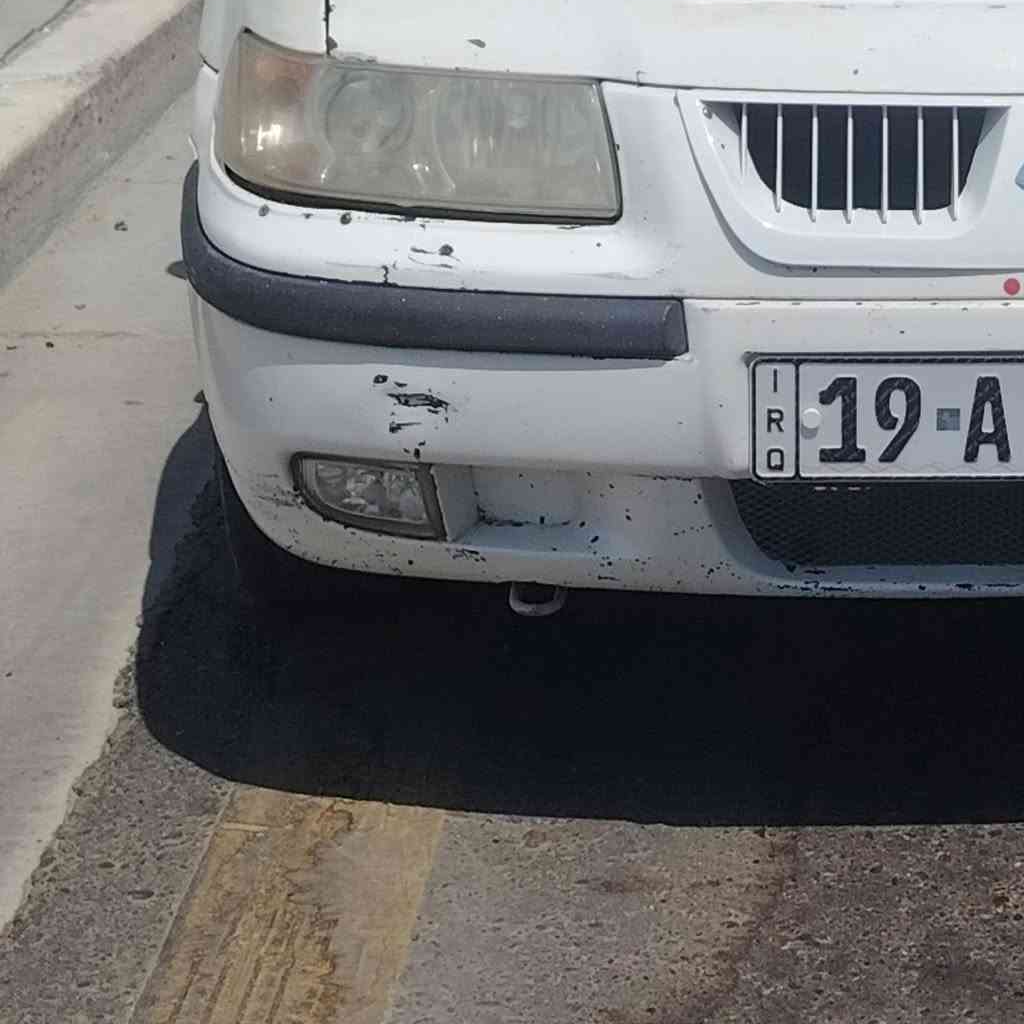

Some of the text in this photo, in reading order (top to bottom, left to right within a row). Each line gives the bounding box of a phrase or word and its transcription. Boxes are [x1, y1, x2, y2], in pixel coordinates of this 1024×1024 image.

[766, 367, 786, 472] IRQ
[818, 376, 923, 463] 19
[963, 375, 1012, 463] A
